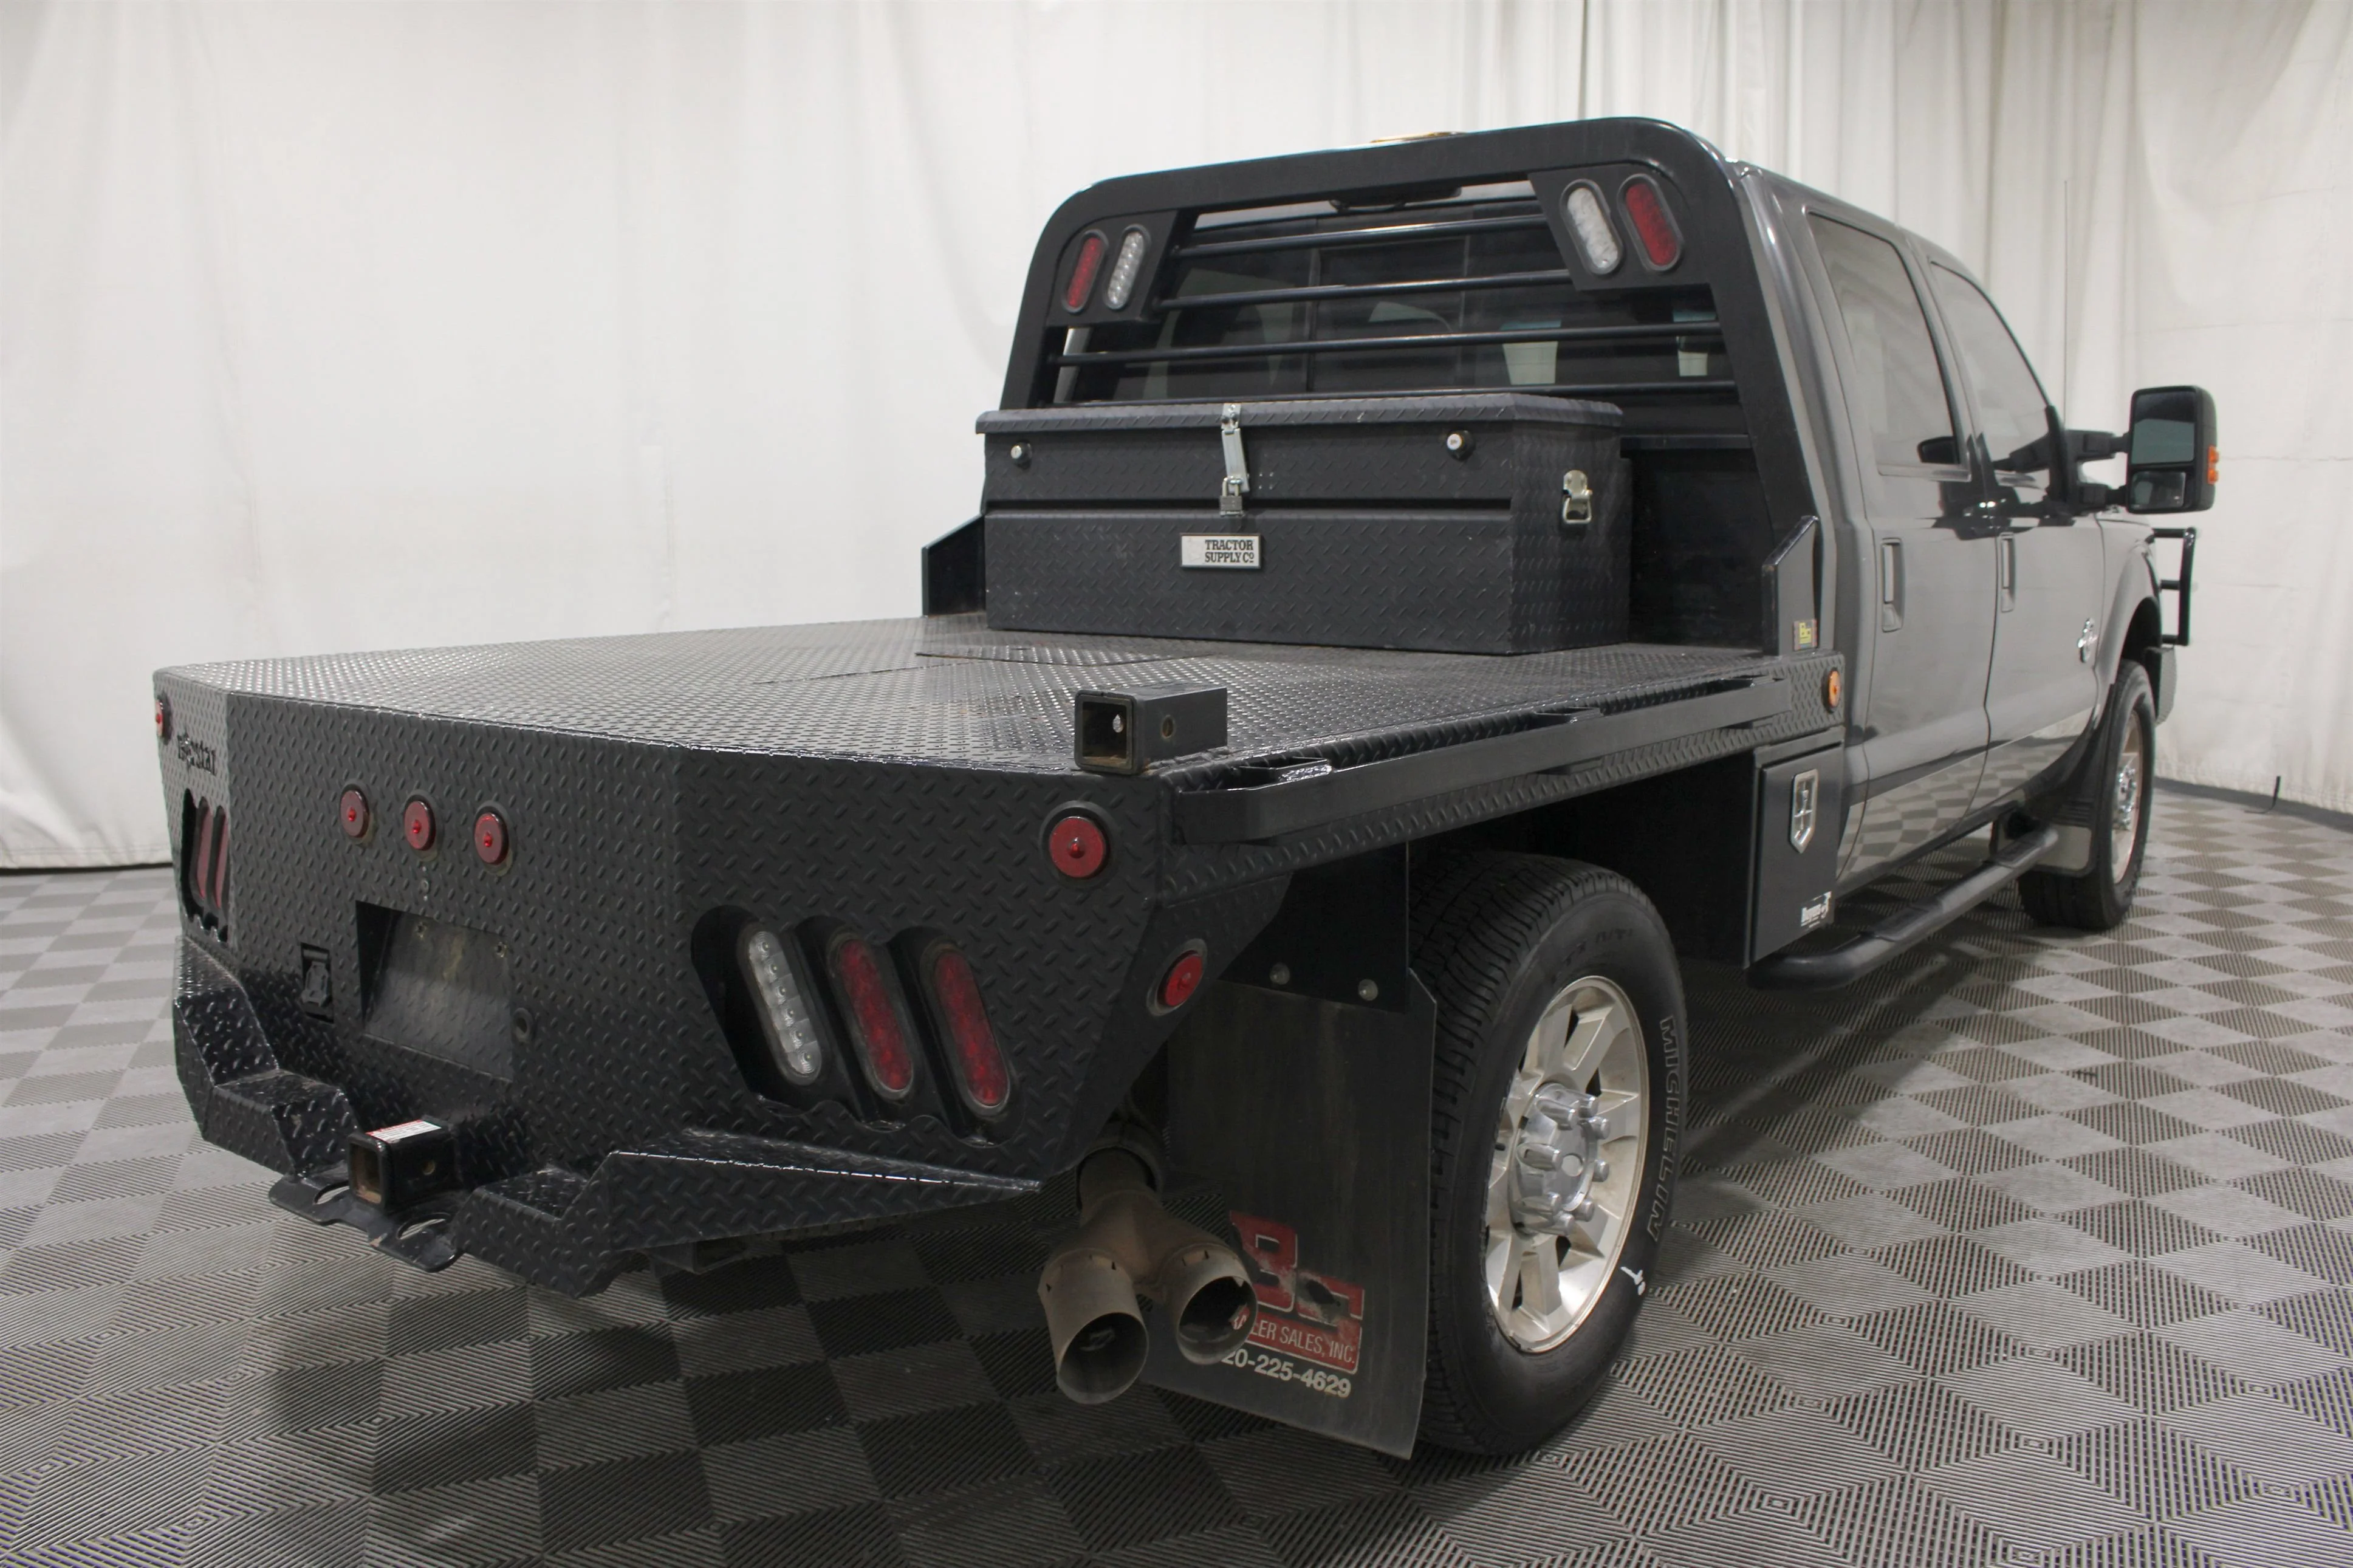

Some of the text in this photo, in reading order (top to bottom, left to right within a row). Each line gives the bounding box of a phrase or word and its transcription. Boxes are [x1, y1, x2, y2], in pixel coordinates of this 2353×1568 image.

[1205, 539, 1254, 550] TRACTOR
[1205, 552, 1240, 563] SUPPLY
[1647, 1015, 1680, 1242] MICHELIN
[1279, 1326, 1325, 1357] SALES,
[1329, 1340, 1355, 1364] INC.
[1221, 1348, 1352, 1398] 20-225-4629
